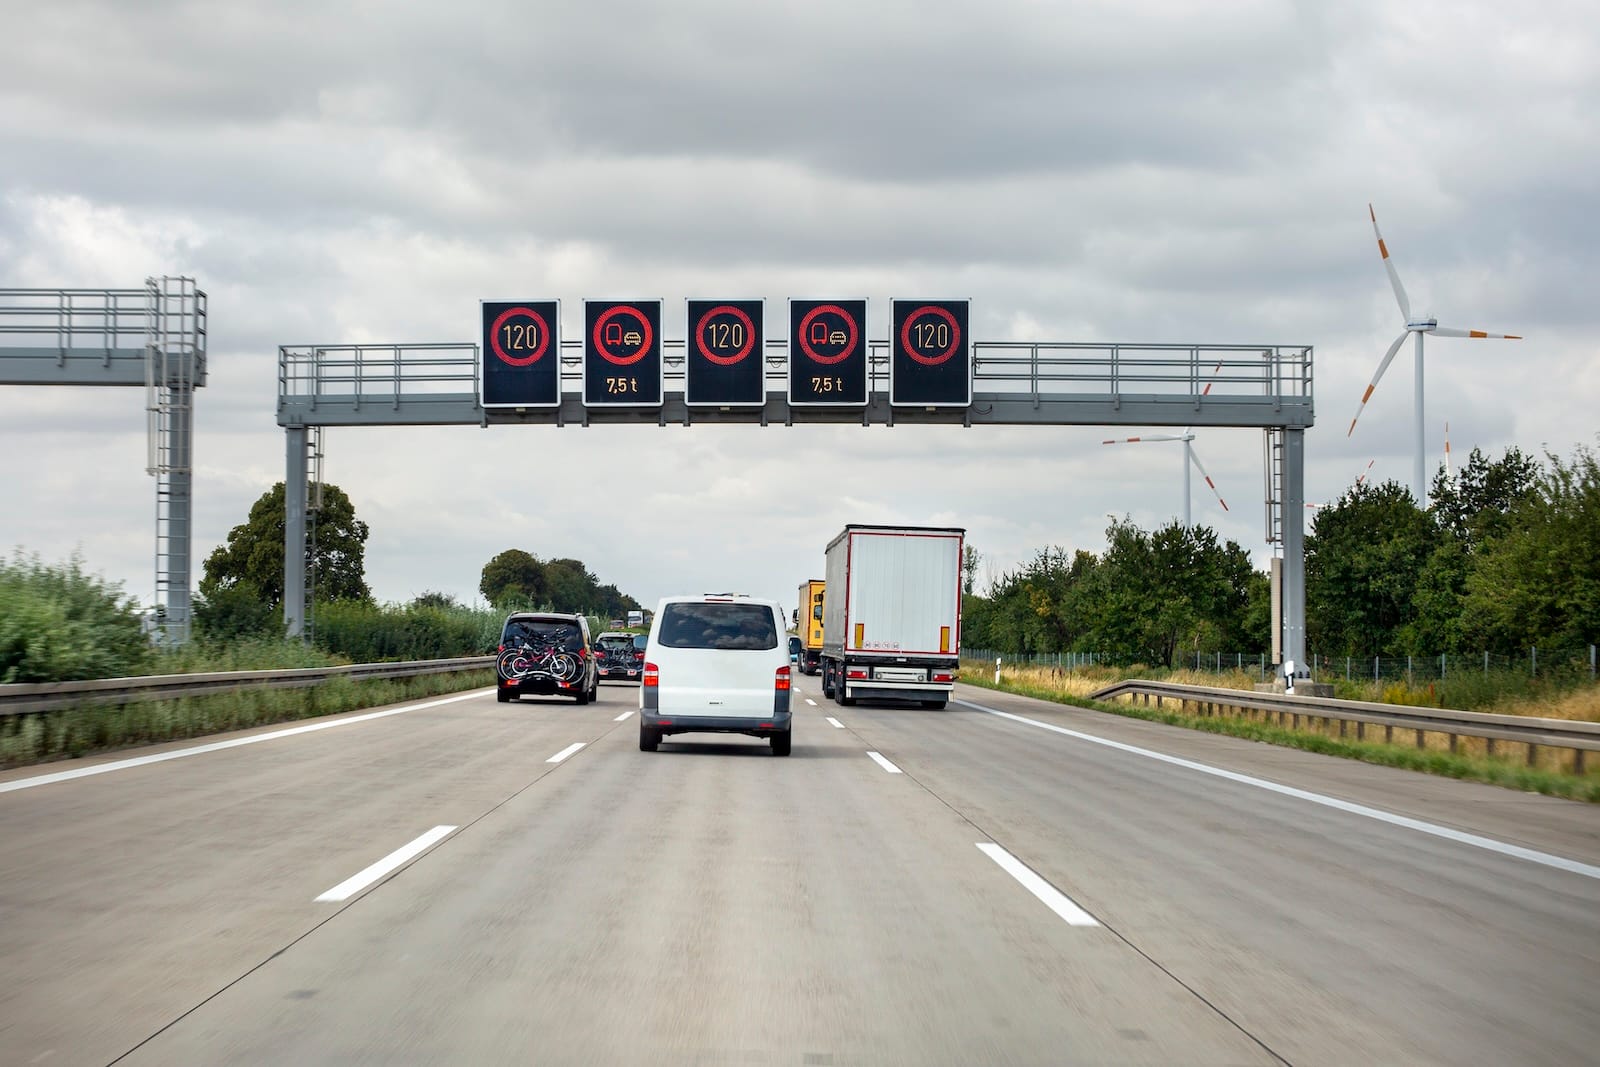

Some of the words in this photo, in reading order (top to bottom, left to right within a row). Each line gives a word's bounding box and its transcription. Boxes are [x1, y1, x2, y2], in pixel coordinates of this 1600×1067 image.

[503, 324, 537, 350] 120
[709, 323, 743, 348] 120
[914, 323, 948, 349] 120
[606, 377, 627, 394] 7,5
[630, 378, 638, 393] t
[811, 377, 833, 394] 7,5
[836, 378, 843, 393] t
